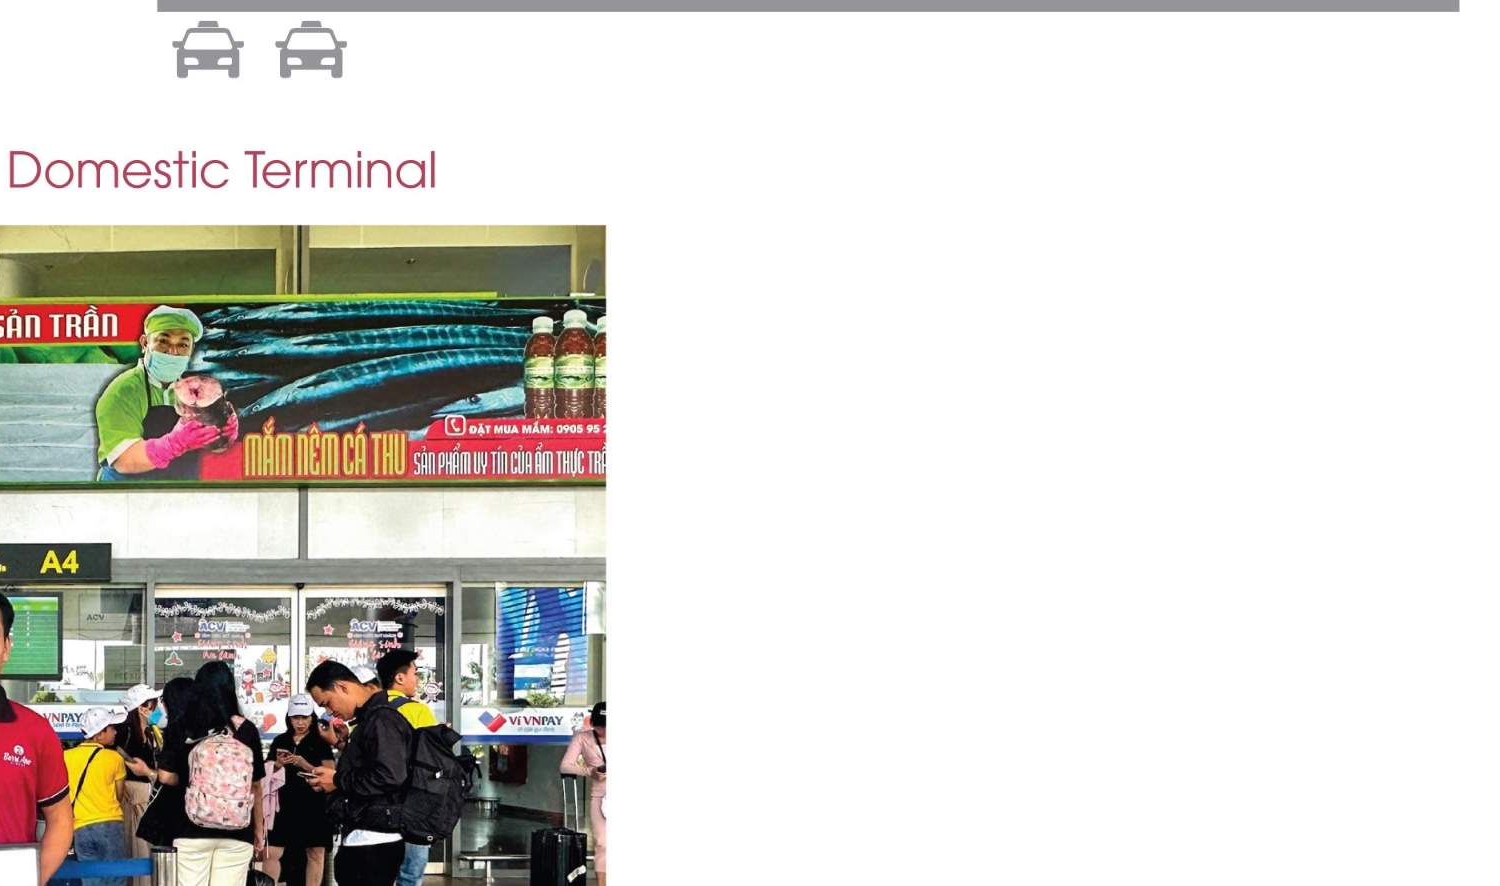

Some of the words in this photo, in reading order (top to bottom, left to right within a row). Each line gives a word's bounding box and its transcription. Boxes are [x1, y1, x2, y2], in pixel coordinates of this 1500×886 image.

[49, 305, 118, 338] TRẦN
[469, 424, 491, 437] ĐẶT
[493, 425, 519, 434] MUA
[556, 424, 583, 434] 0905
[587, 424, 600, 434] 95
[297, 421, 339, 476] NÊM
[343, 421, 366, 475] CÁ
[371, 433, 406, 474] THU
[413, 446, 436, 475] SẢN
[438, 443, 471, 475] PHẨM
[474, 451, 488, 474] UY
[491, 447, 509, 474] TÍN
[511, 445, 532, 474] CỦA
[535, 442, 554, 474] ẨM
[557, 447, 584, 477] THỰC
[40, 549, 79, 574] A4
[200, 622, 224, 630] ACV
[352, 622, 376, 630] ACV
[523, 716, 564, 726] VNPAY
